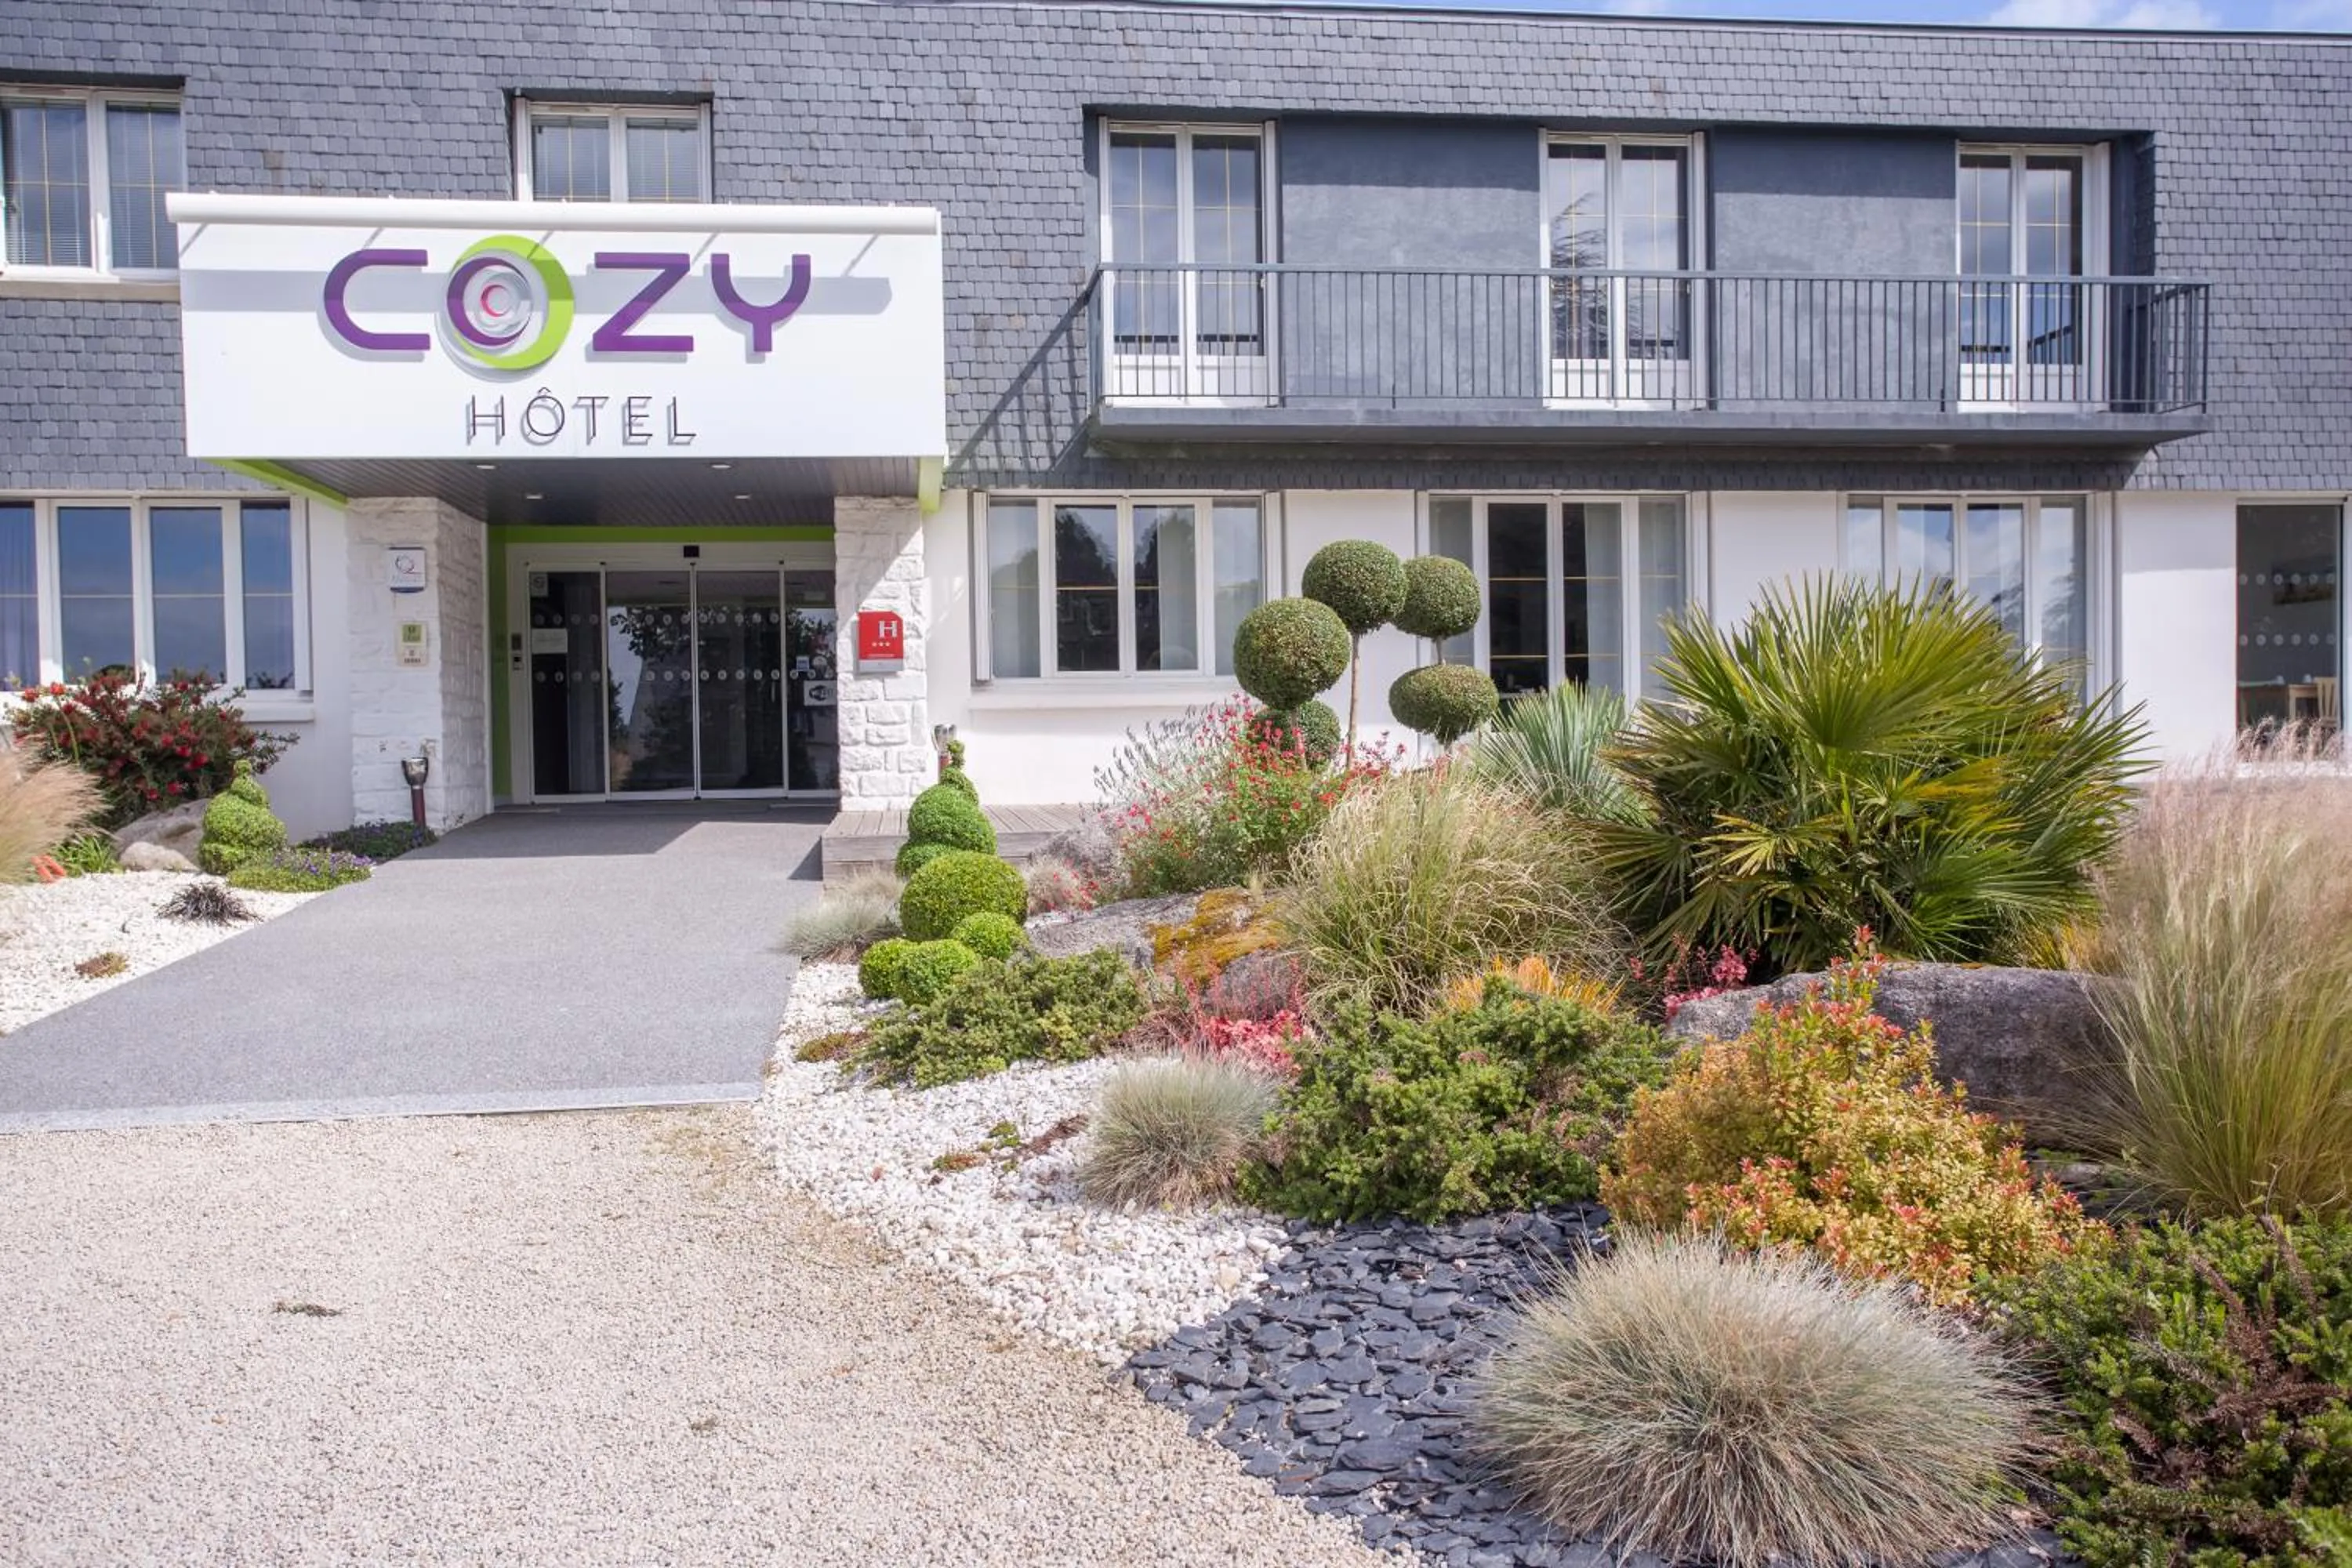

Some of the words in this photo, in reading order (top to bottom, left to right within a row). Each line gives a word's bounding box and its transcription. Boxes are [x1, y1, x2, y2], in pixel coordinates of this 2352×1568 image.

[324, 235, 811, 370] COZY
[472, 387, 696, 437] HÔTEL
[879, 620, 898, 637] H
